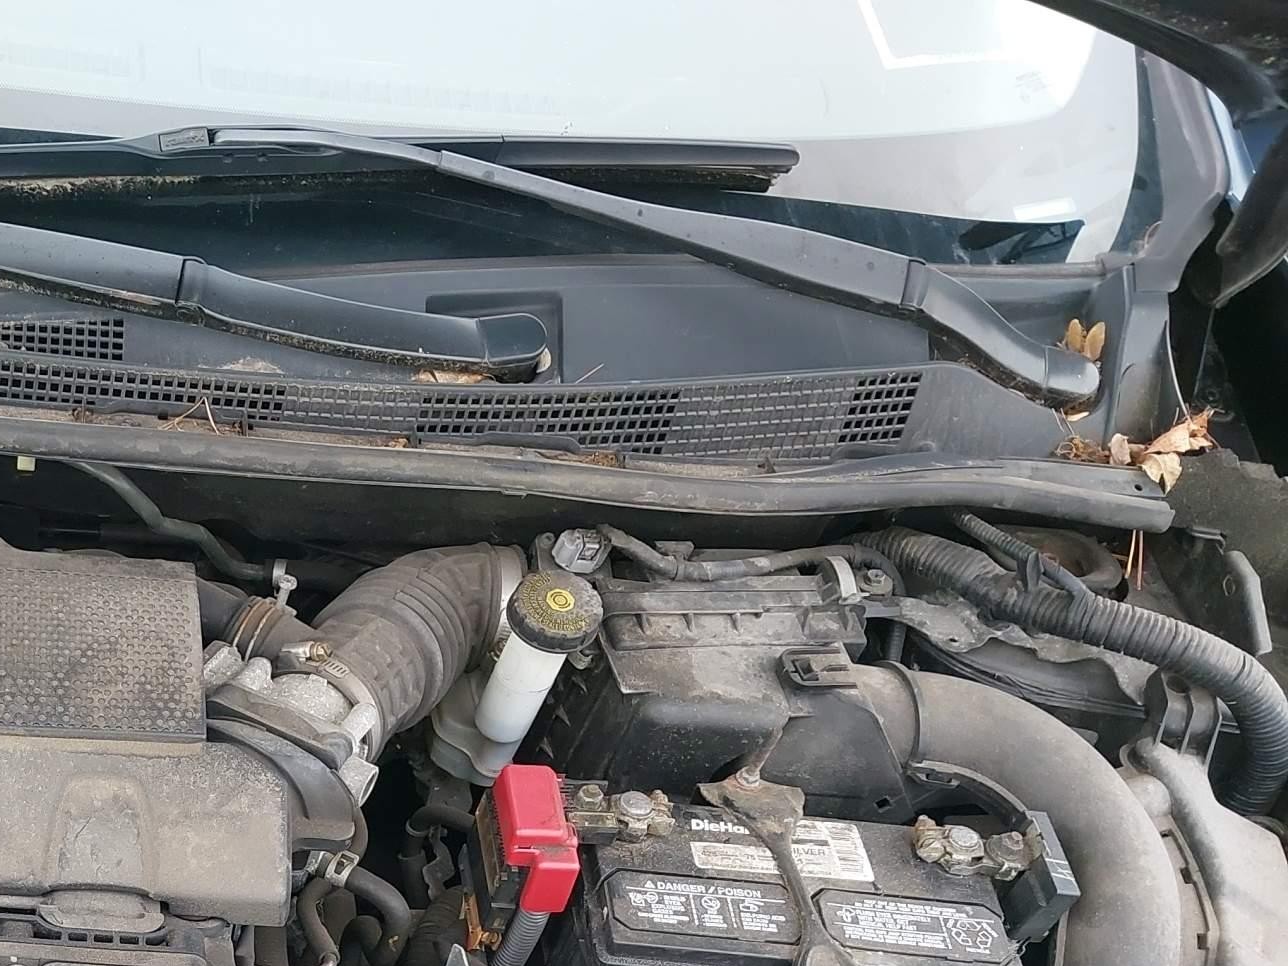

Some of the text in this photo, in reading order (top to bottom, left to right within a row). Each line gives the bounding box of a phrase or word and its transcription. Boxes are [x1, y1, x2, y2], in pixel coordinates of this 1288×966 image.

[792, 847, 826, 856] ILVER
[656, 881, 706, 894] DANGER
[717, 887, 761, 898] POISON
